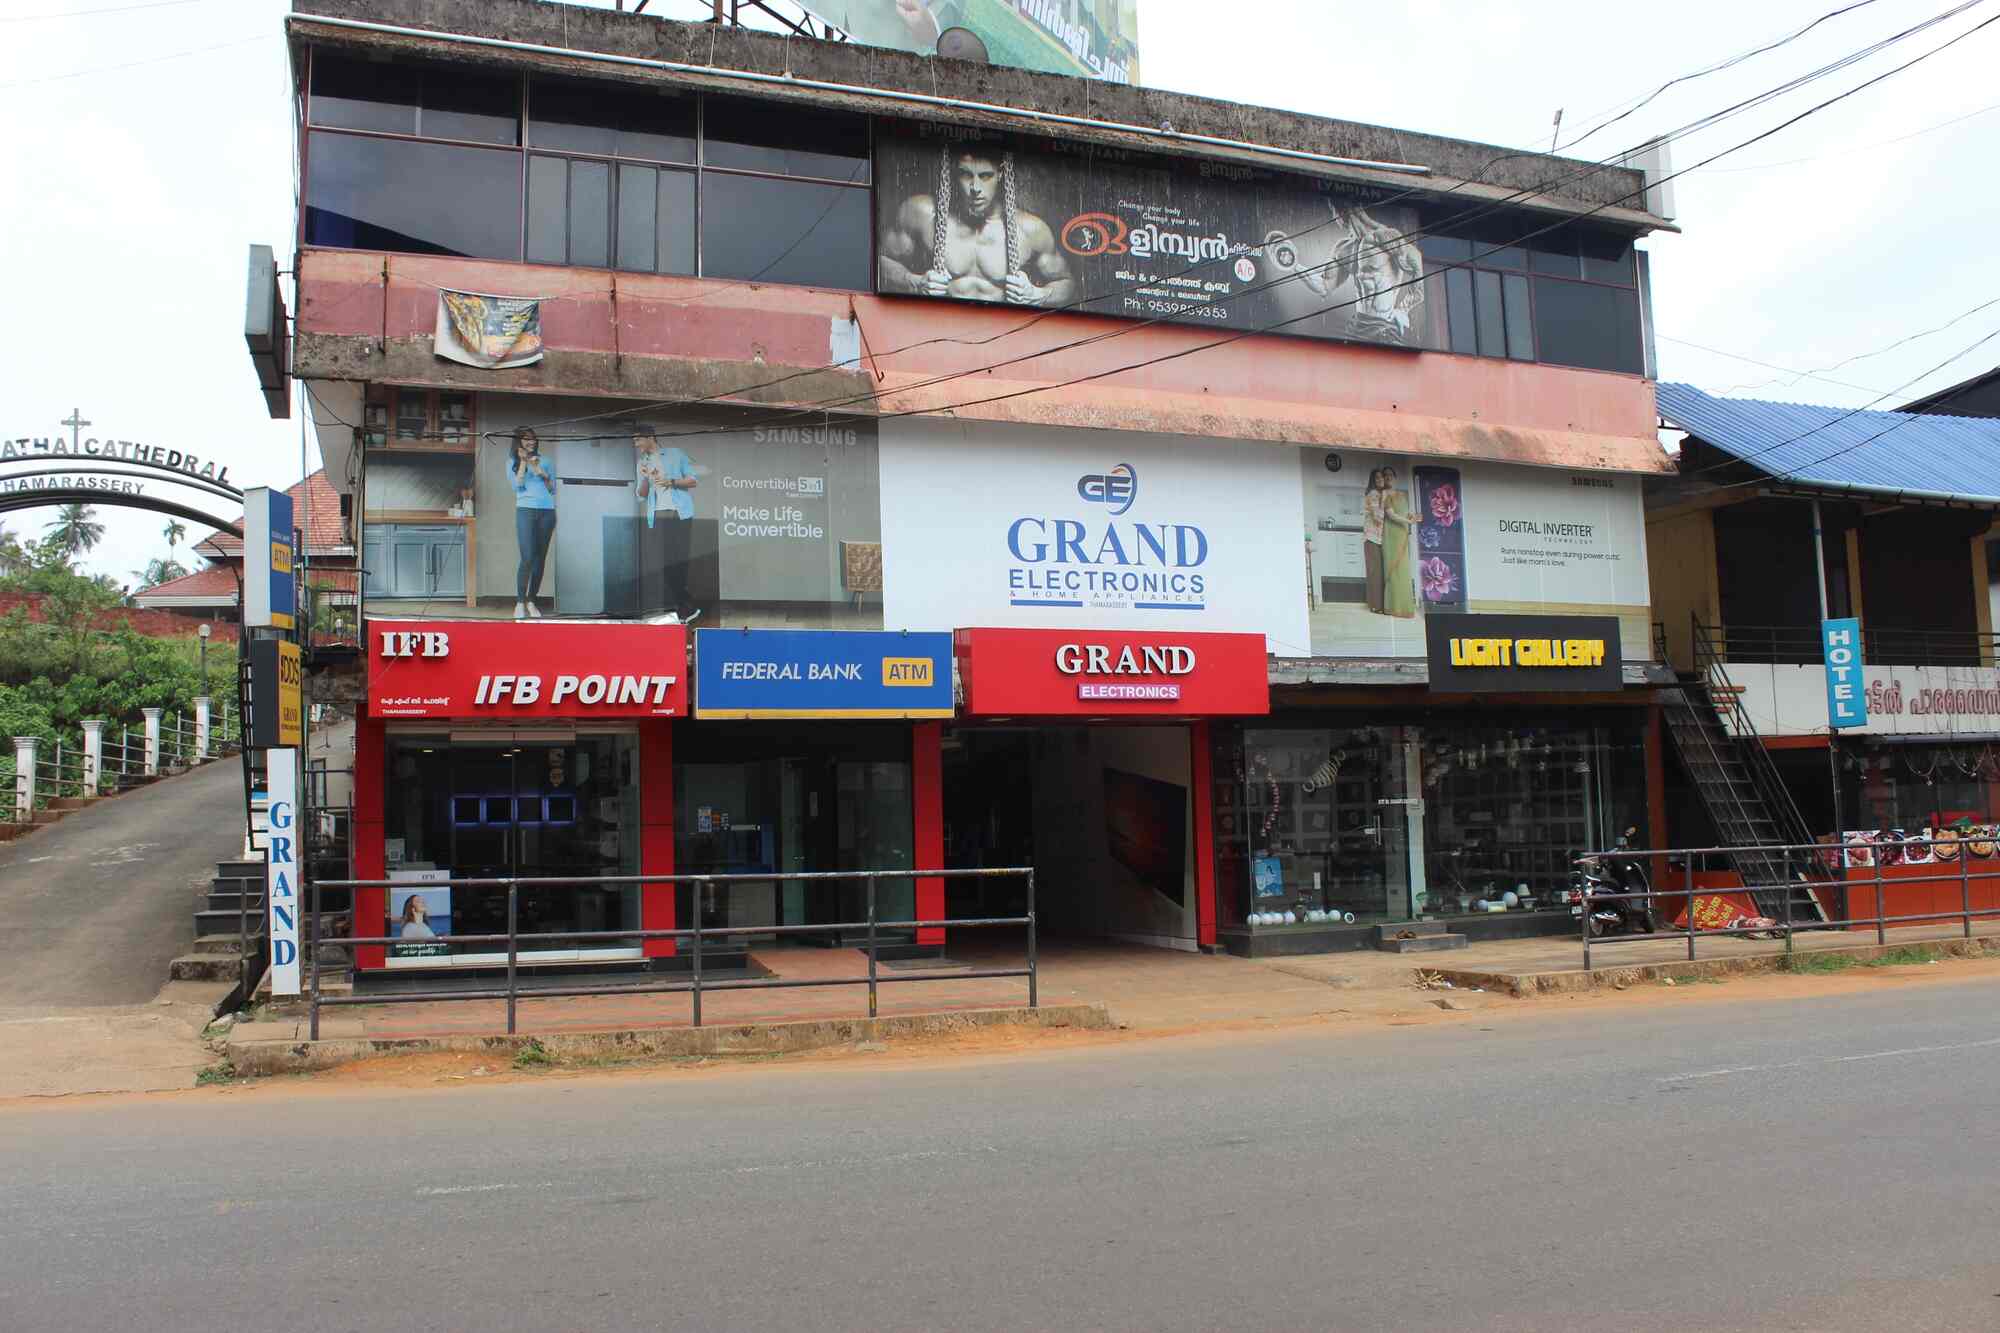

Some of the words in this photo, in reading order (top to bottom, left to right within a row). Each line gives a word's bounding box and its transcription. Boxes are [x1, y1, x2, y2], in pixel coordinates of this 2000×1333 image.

[1124, 297, 1144, 309] Ph:
[753, 425, 858, 448] SAMSUNG
[84, 437, 230, 484] CATHEDRAL
[0, 476, 145, 495] HAMARASSERY
[723, 475, 797, 490] Convertible
[723, 505, 769, 521] Make
[774, 506, 803, 522] Life
[723, 522, 823, 538] Convertible
[1499, 519, 1541, 535] DIGITAL
[1543, 522, 1593, 537] INVERTER
[1007, 517, 1209, 568] GRAND
[1009, 568, 1205, 593] ELECTRONICS
[1032, 591, 1079, 599] HOME
[1093, 592, 1206, 602] APPLIANCES
[380, 631, 450, 658] IFB
[1450, 638, 1513, 666] LIGHT
[1055, 644, 1196, 674] GRAND
[722, 662, 802, 681] FEDERAL
[808, 663, 863, 682] BANK
[888, 663, 928, 681] ATM
[1828, 629, 1856, 719] HOTEL
[474, 675, 543, 705] IFB
[550, 675, 677, 706] POINT
[1081, 686, 1178, 699] ELECTRONICS
[269, 801, 298, 966] GRAND
